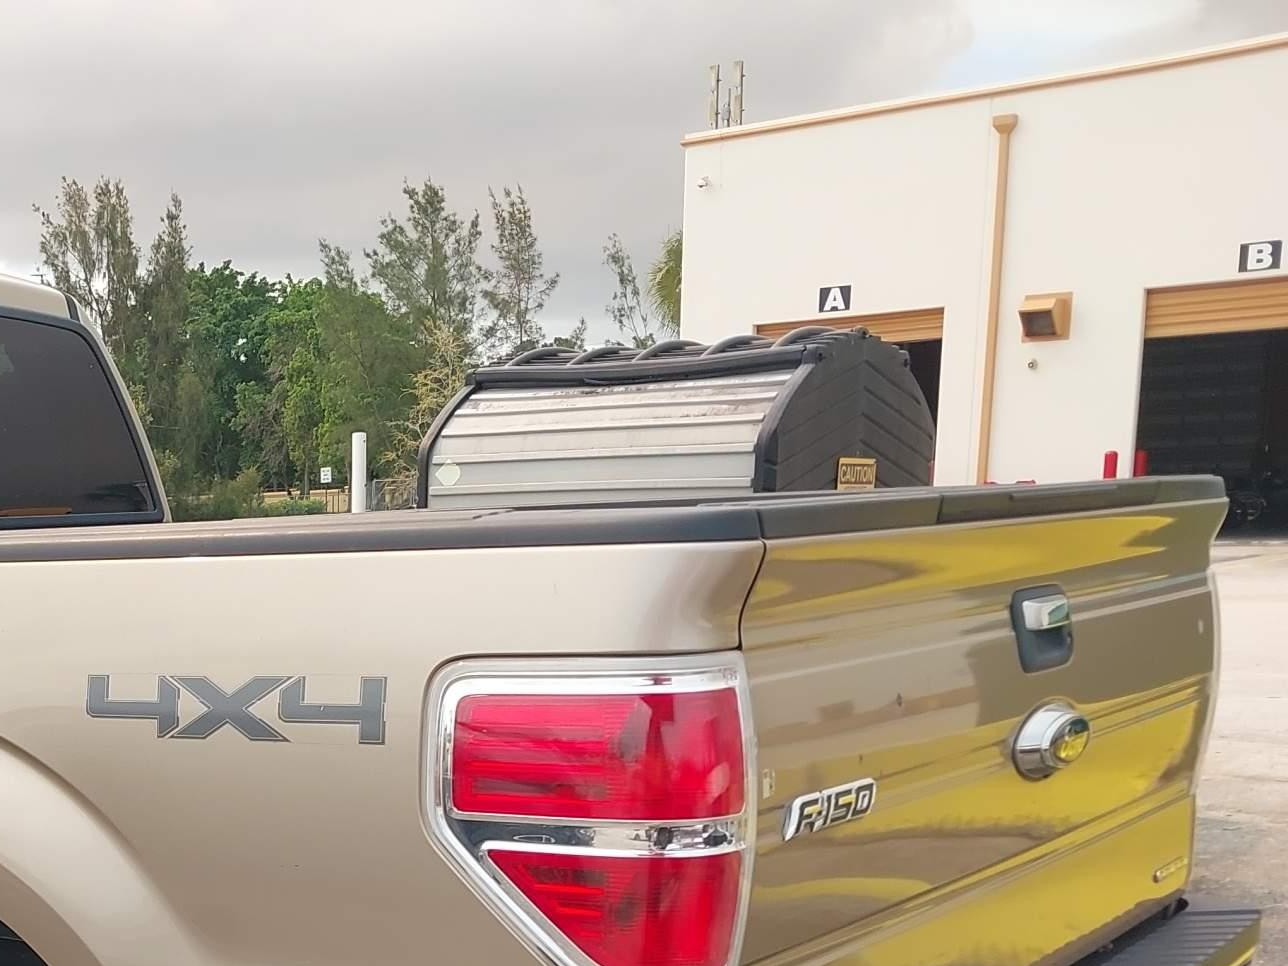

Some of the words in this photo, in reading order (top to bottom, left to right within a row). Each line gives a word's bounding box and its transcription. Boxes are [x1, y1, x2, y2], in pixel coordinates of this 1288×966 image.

[1247, 243, 1273, 270] B
[823, 287, 845, 311] A
[840, 465, 873, 483] CAUTION
[86, 674, 387, 745] 4X4
